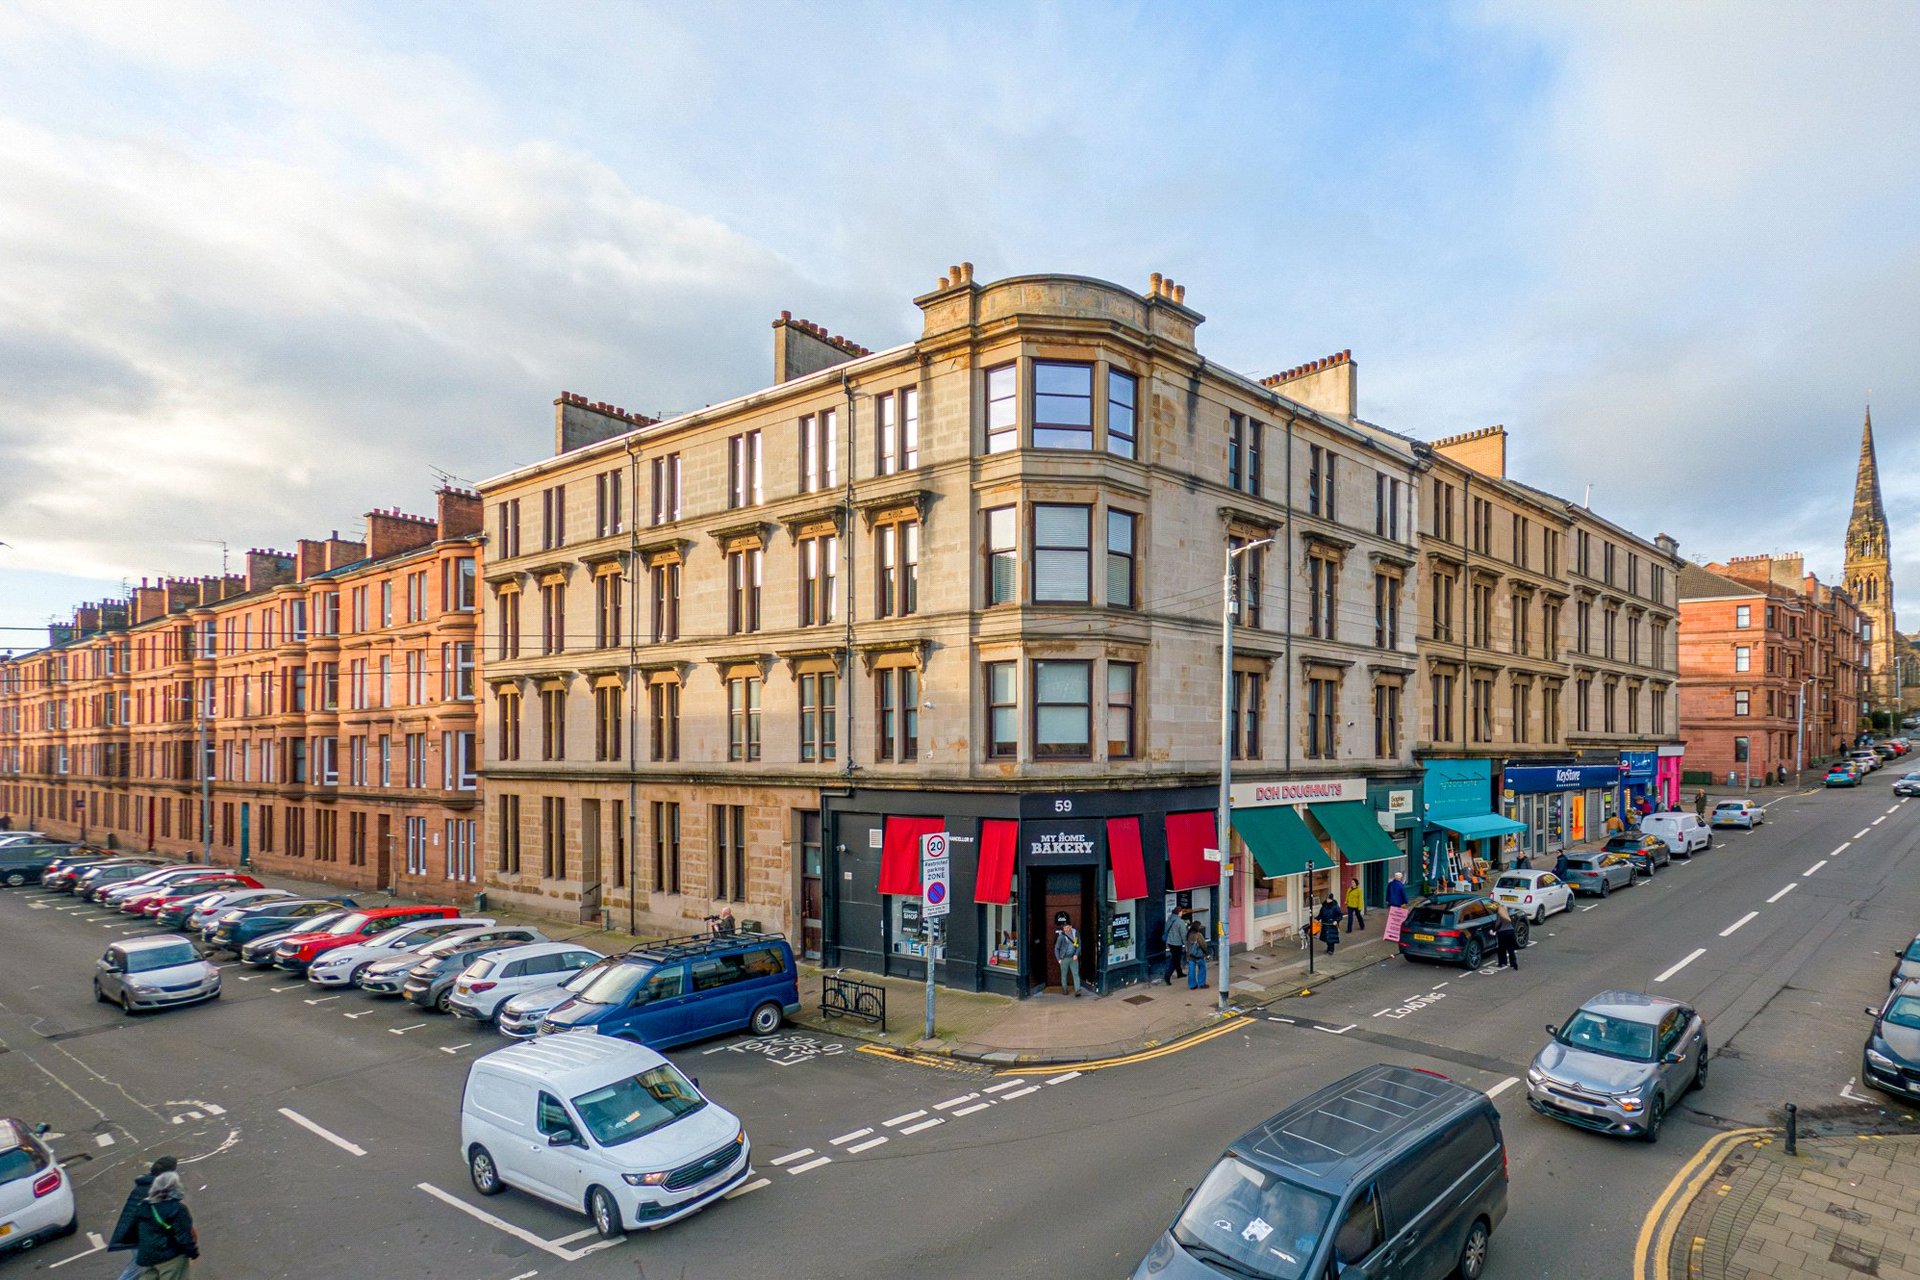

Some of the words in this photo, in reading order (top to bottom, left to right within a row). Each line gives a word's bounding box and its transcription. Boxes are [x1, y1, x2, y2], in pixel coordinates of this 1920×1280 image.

[1556, 769, 1580, 783] KeyStore
[1256, 786, 1280, 801] DOH
[1282, 783, 1342, 800] DOUGHNUTS
[1054, 799, 1073, 812] 59
[1040, 834, 1057, 843] MY
[1058, 833, 1086, 842] HOME
[930, 841, 943, 852] 20
[1031, 841, 1094, 855] BAKERY
[927, 866, 945, 874] parking
[927, 872, 945, 881] ZONE
[1386, 992, 1447, 1019] LOADING
[745, 1042, 803, 1060] ONLY
